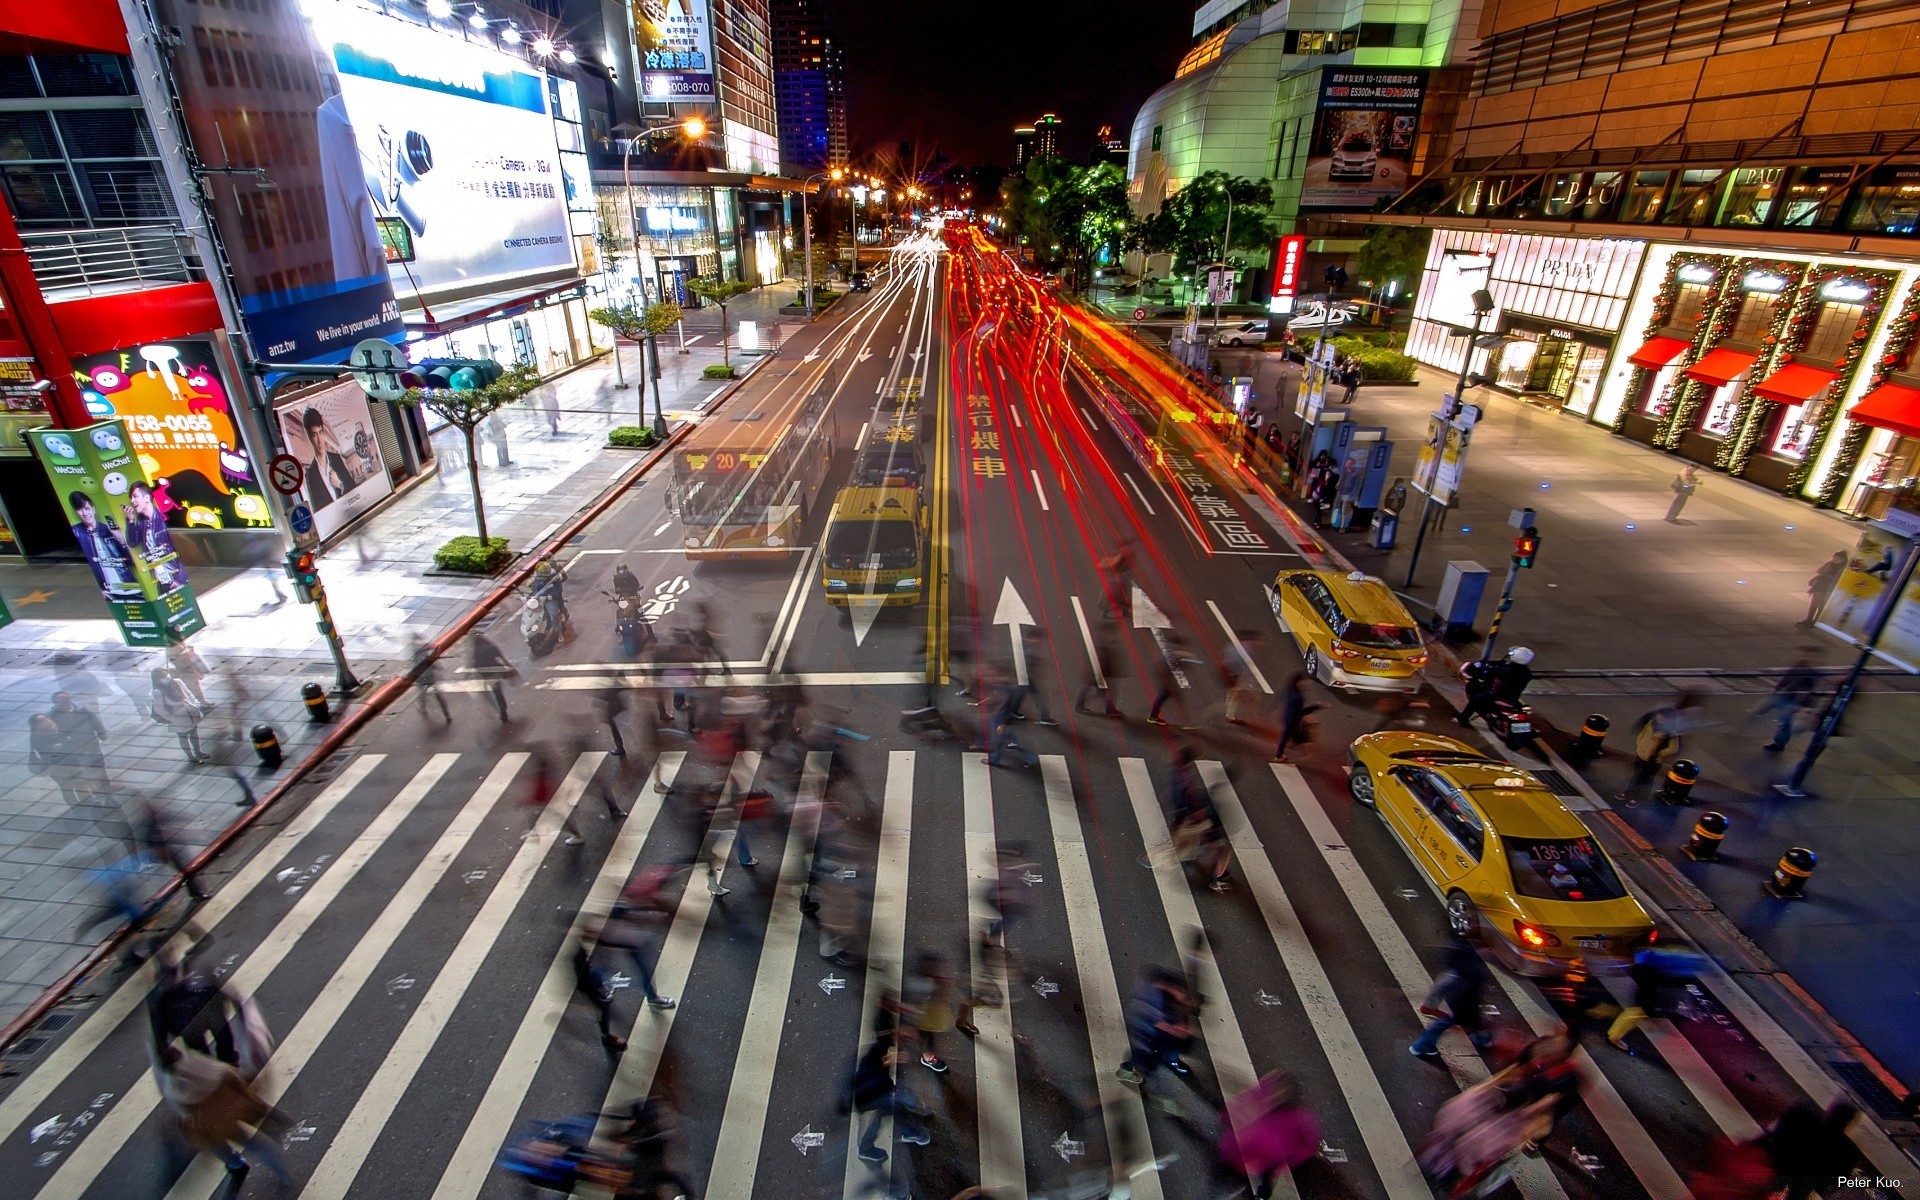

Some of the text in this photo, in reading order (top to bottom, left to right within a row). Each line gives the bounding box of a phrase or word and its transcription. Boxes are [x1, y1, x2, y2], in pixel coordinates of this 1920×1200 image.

[645, 82, 710, 92] 0-008-070
[532, 237, 549, 246] CAMERA
[382, 300, 400, 323] ANZ
[316, 314, 380, 342] We live in your world
[268, 340, 296, 357] anz.tw
[112, 414, 213, 432] 758-0055
[966, 393, 1007, 479] 禁行機車
[102, 456, 131, 471] WeChat
[716, 453, 735, 469] 20
[54, 466, 87, 474] WeChat
